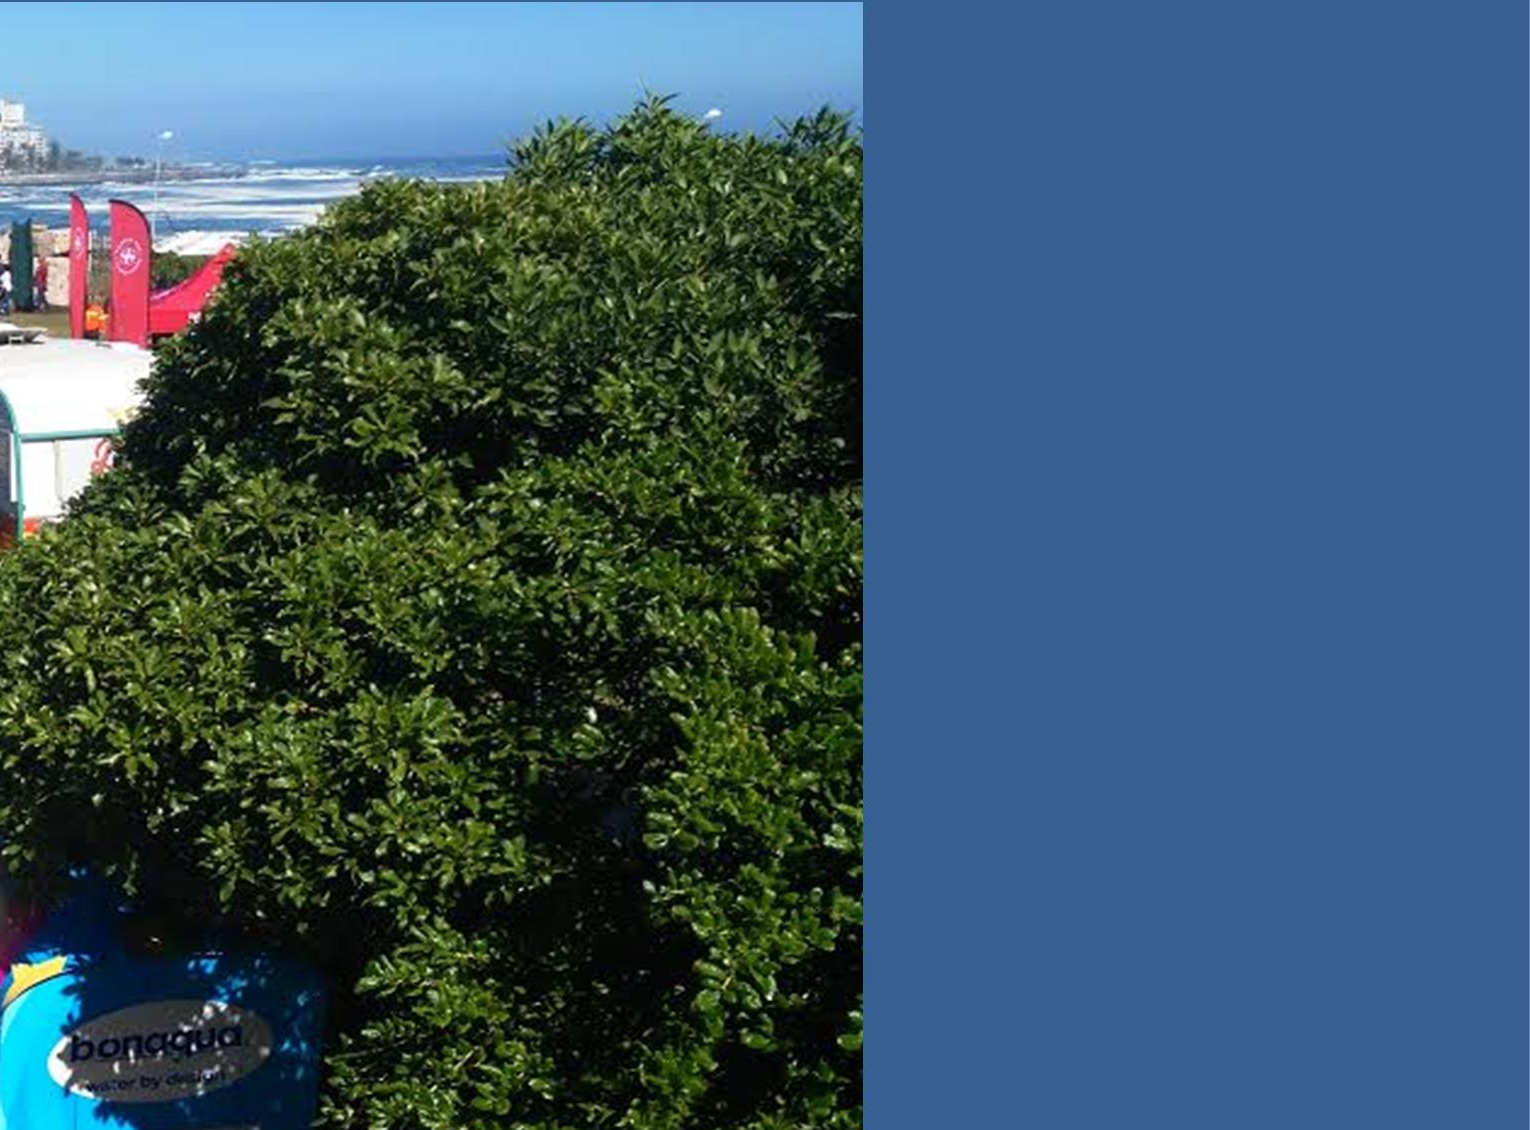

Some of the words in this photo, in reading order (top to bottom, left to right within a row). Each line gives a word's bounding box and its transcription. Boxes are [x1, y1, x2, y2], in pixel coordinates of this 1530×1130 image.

[70, 1025, 243, 1062] bonaqua
[86, 1076, 134, 1093] water
[140, 1075, 160, 1092] by
